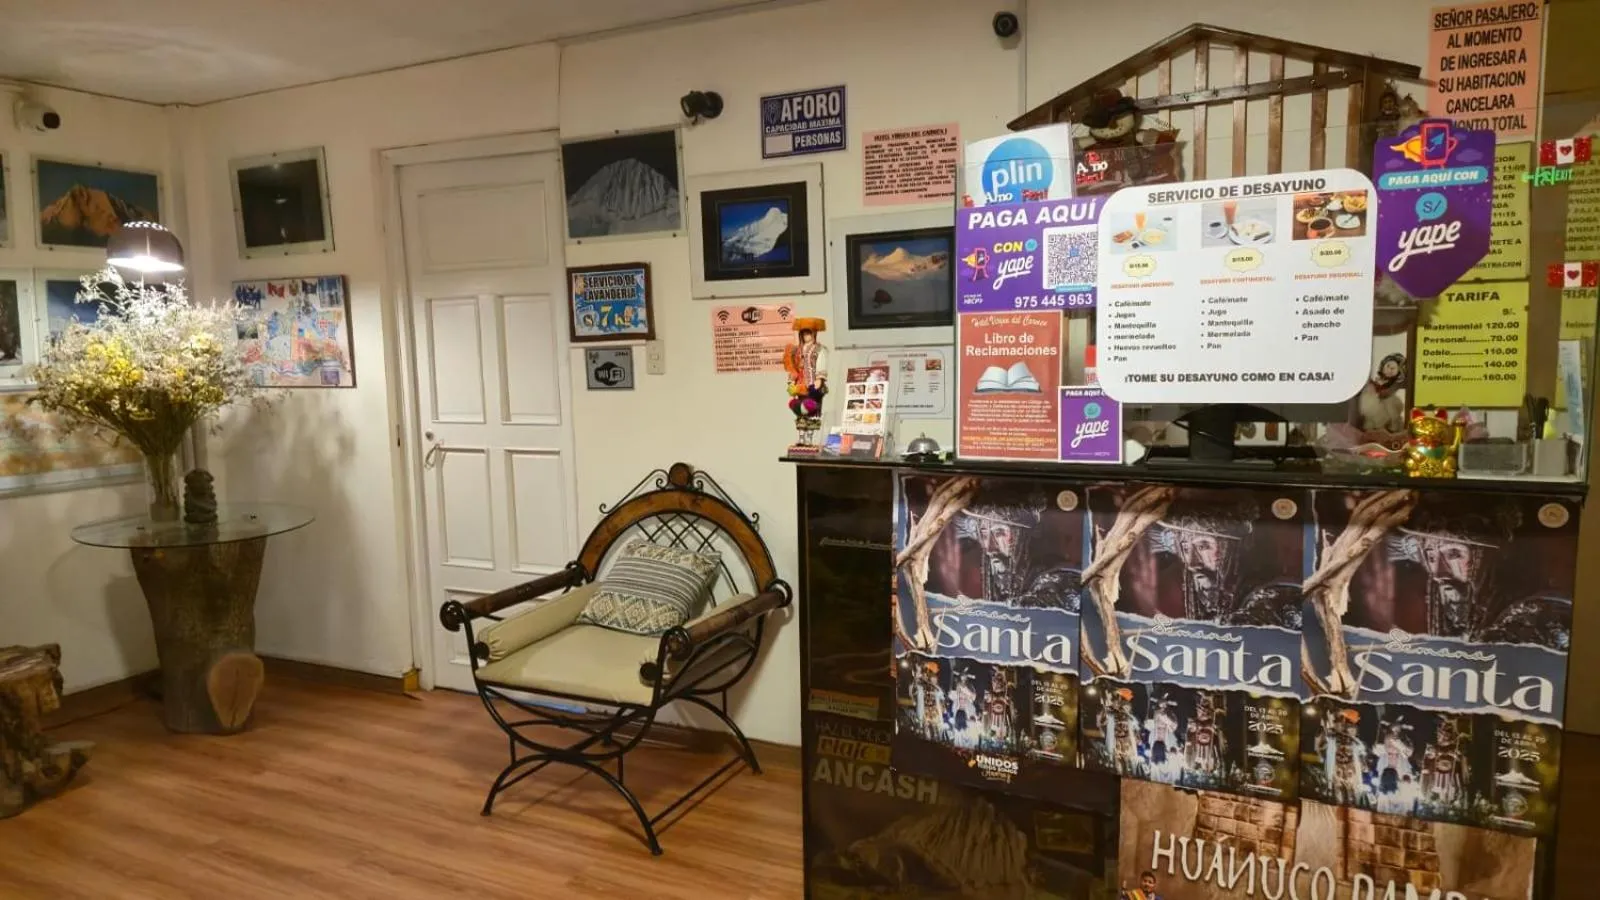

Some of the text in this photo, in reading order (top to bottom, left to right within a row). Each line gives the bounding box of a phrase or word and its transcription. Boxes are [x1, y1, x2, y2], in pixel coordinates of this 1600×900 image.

[1434, 2, 1539, 28] SEÑOR PASAJERO:
[1447, 26, 1522, 49] AL MOMENTO
[1441, 48, 1527, 72] DE INGRESAR A
[1438, 70, 1526, 93] SU HABITACION
[781, 91, 841, 123] AFORO
[1446, 93, 1515, 114] CANCELARA
[765, 117, 841, 134] CAPACIDAD MAXIMA
[1455, 114, 1527, 132] ONTO TOTAL
[795, 131, 841, 149] PERSONAS
[991, 160, 1043, 193] plin
[1388, 169, 1479, 187] PAGA AQUÍ CON
[1148, 177, 1326, 205] SERVICIO DE DESAYUNO
[967, 197, 1096, 230] PAGA AQUÍ
[993, 241, 1023, 254] CON
[1388, 220, 1462, 273] yape
[992, 255, 1034, 291] yape
[583, 275, 623, 289] SERVICIO
[1014, 294, 1093, 308] 975 445 963
[1302, 294, 1350, 303] Café/mate
[1446, 291, 1501, 303] TARIFA
[1302, 307, 1345, 316] Asado de
[1207, 318, 1254, 328] Mantequilla
[1301, 320, 1342, 329] chancho
[1486, 321, 1519, 330] 120.00
[985, 331, 1034, 345] Libro de
[1207, 342, 1222, 350] Pan
[1301, 333, 1319, 342] Pan
[1490, 334, 1518, 342] 70.00
[966, 345, 1057, 357] Reclamaciones
[1485, 347, 1518, 355] 110.00
[1485, 360, 1518, 369] 140.00
[1160, 374, 1175, 383] SU
[1177, 373, 1239, 383] DESAYUNO
[1241, 372, 1276, 382] COMO
[1279, 372, 1296, 381] EN
[1299, 371, 1335, 382] CASA!
[1070, 420, 1110, 449] yape
[933, 613, 1071, 666] Santa
[1126, 633, 1292, 688] Santa
[1353, 650, 1554, 714] Santa
[1248, 720, 1284, 735] 2025
[976, 754, 1018, 770] UNIDOS
[1497, 746, 1541, 762] 2025
[812, 757, 940, 805] ANCASH
[1150, 829, 1338, 900] HUÁNUCO
